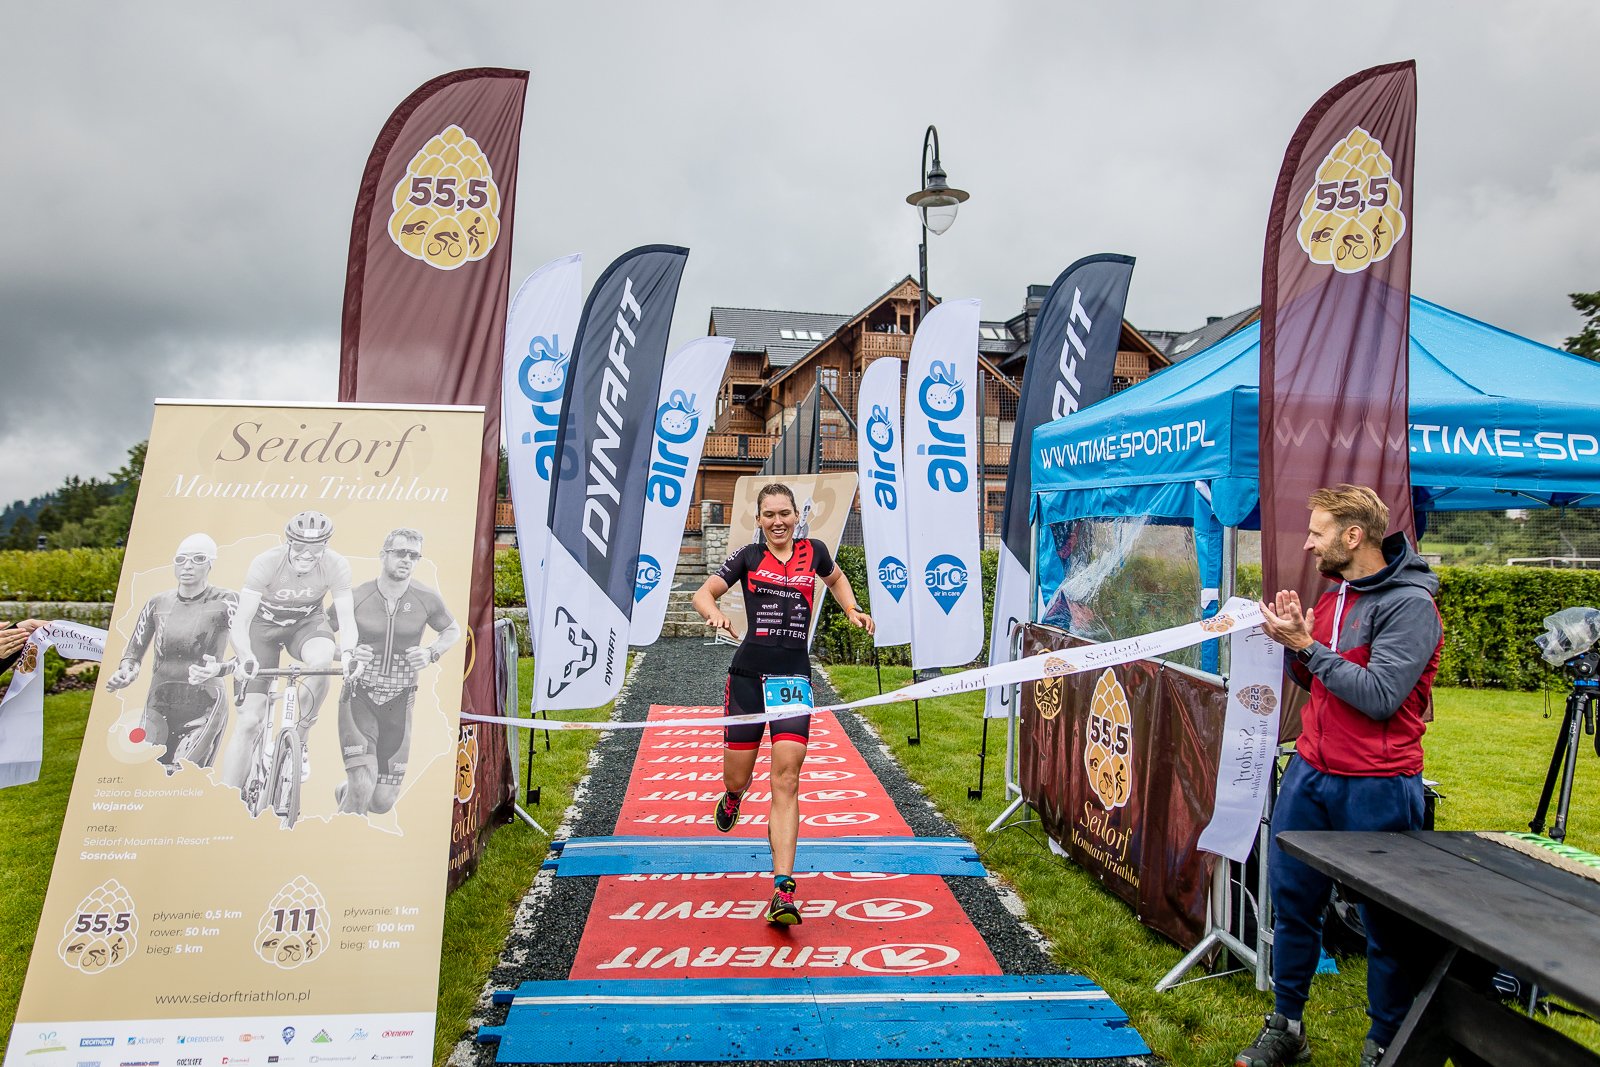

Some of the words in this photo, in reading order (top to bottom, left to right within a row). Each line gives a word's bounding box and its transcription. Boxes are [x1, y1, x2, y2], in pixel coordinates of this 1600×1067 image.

[408, 177, 489, 212] 55,5
[1314, 177, 1389, 213] 55,5
[1051, 287, 1093, 421] AFIT
[581, 276, 642, 558] DYNAFIT
[215, 421, 427, 478] Seidorf
[1040, 420, 1216, 470] WWW.TIME-SPORT.PL
[163, 473, 309, 499] Mountain
[312, 474, 450, 502] Triathlon
[755, 569, 815, 584] ROMET
[756, 587, 802, 600] XTRABIKE
[769, 628, 807, 640] PETTERS
[604, 627, 617, 687] DYNAFIT
[780, 686, 804, 703] 94
[285, 693, 295, 720] BMC
[1090, 716, 1129, 755] 55,5
[97, 776, 124, 784] start:
[94, 788, 131, 799] Jezioro
[134, 787, 204, 798] Bobrownickie
[92, 802, 144, 813] Wojanów
[86, 824, 117, 833] meta:
[1080, 800, 1133, 862] Seidorf
[83, 837, 124, 846] Seidorf
[124, 836, 174, 846] Mountain
[176, 836, 210, 845] Resort
[79, 851, 137, 861] Sosnówka
[153, 911, 203, 922] pływanie:
[205, 910, 222, 920] 0,5
[224, 909, 242, 919] km
[344, 907, 393, 918] pływanie:
[395, 906, 400, 915] 1
[401, 906, 420, 915] km
[74, 913, 131, 936] 55,5
[273, 908, 316, 932] 111
[342, 924, 374, 932] rower:
[376, 923, 395, 932] 100
[397, 922, 415, 932] km
[149, 929, 183, 937] rower:
[185, 927, 200, 936] 50
[201, 927, 220, 936] km
[146, 945, 173, 955] bieg:
[175, 945, 182, 953] 5
[185, 944, 203, 953] km
[340, 940, 366, 951] bieg:
[368, 940, 380, 949] 10
[382, 940, 400, 948] km
[154, 989, 311, 1004] www.seidorftriathlon.pl
